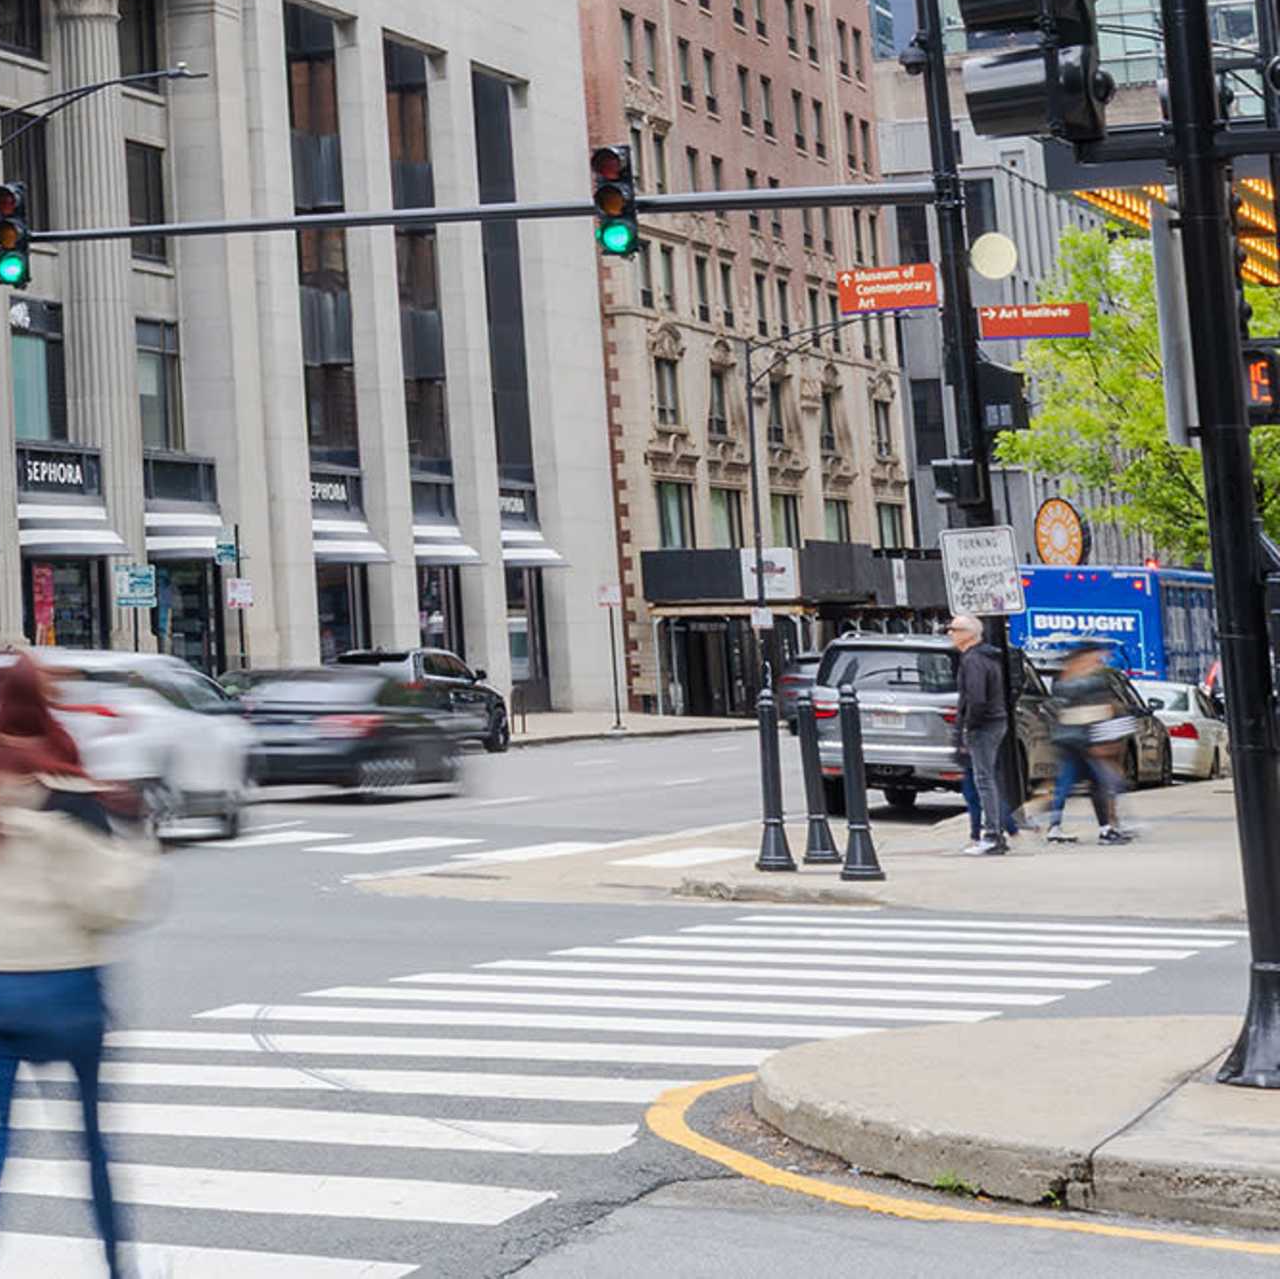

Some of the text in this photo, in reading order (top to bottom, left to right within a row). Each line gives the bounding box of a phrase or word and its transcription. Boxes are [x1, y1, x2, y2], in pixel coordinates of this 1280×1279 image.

[855, 265, 915, 282] Museum of
[856, 281, 932, 296] Contemporary
[858, 298, 876, 310] Art
[999, 306, 1070, 319] Art Institute
[26, 460, 83, 485] SEPHORA
[311, 482, 347, 501] EPHORA
[1033, 614, 1135, 631] BUD LIGHT
